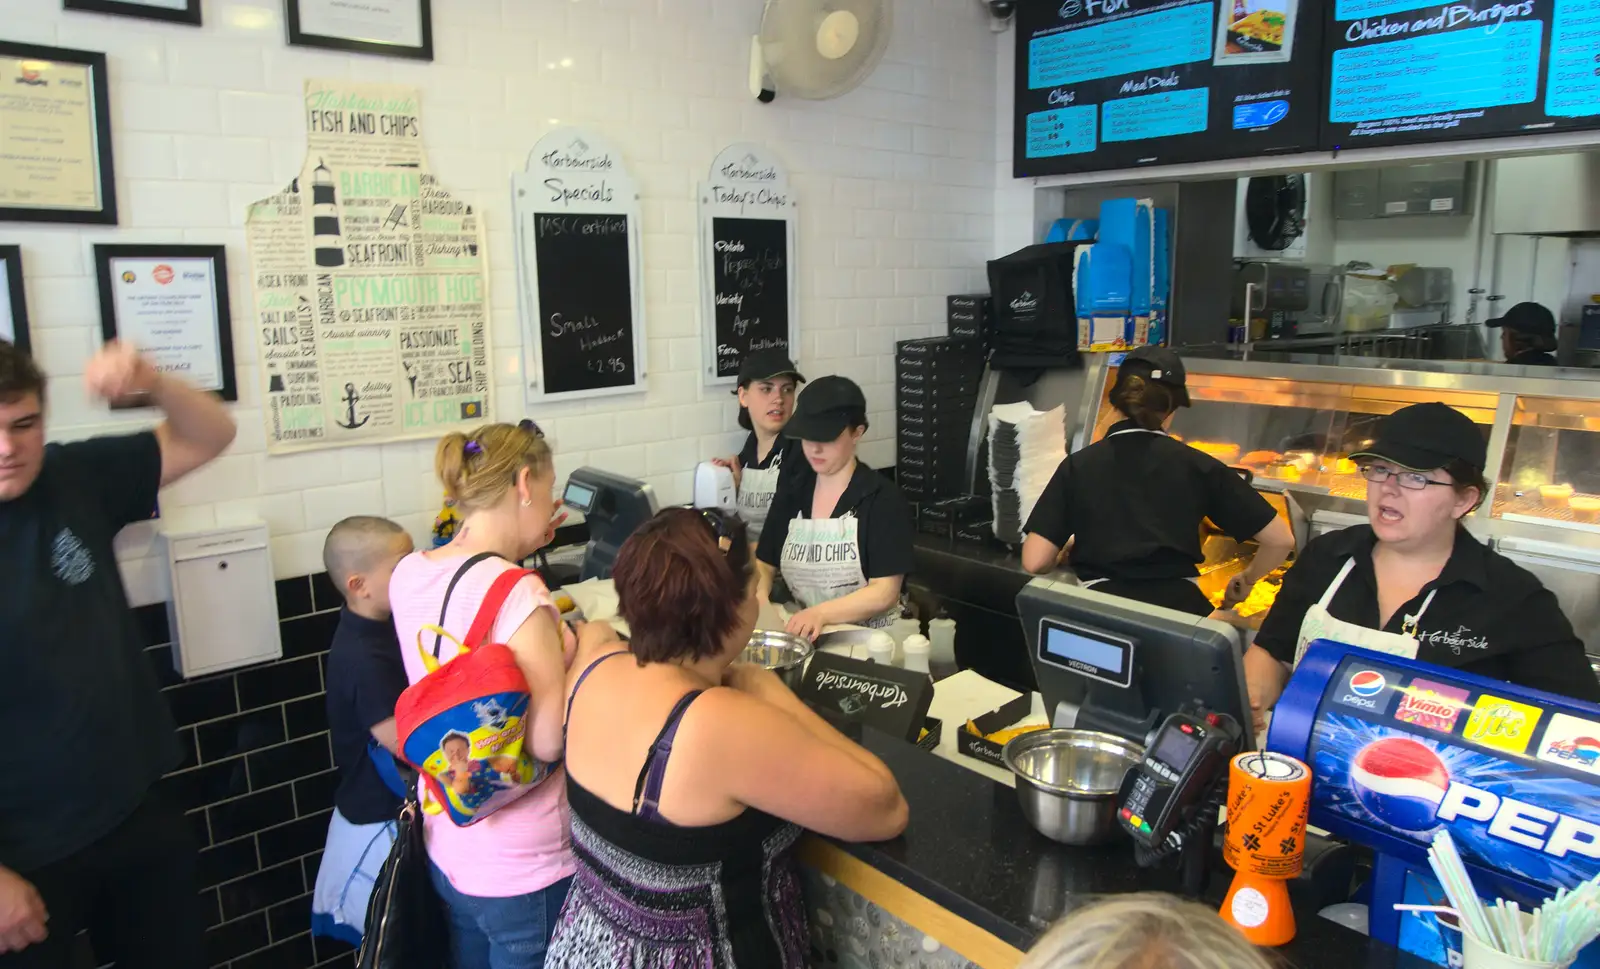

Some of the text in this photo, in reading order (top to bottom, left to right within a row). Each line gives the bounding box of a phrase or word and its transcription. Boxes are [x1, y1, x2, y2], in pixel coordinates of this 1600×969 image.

[1345, 19, 1409, 42] Chicken
[1410, 6, 1448, 32] and
[1446, 0, 1535, 35] Burgers
[1119, 71, 1180, 94] Meal Deals
[1047, 88, 1076, 106] Chips
[311, 109, 418, 137] FISH AND CHIPS
[541, 149, 613, 169] Harbourside
[721, 162, 777, 181] Harbourside
[340, 171, 420, 198] BARBICAN
[544, 177, 614, 207] Specials
[421, 200, 464, 215] HARBOUR
[712, 185, 787, 215] Today's Chips
[347, 243, 408, 263] SEAFRONT
[425, 242, 461, 258] Fishing
[714, 240, 746, 253] Potato
[283, 273, 308, 287] FRONT
[316, 273, 336, 325] BARBICAN
[335, 275, 484, 308] PLYMOUTH HOE
[715, 292, 744, 313] Variety
[261, 310, 297, 325] SALT AIR
[352, 306, 399, 323] SEAFRONT
[297, 304, 317, 357] SEAGULLS
[322, 328, 391, 340] Award winning
[550, 312, 600, 338] Small
[262, 326, 299, 346] SAILS
[399, 329, 460, 350] PASSIONATE
[472, 321, 486, 366] BUILDING
[264, 348, 300, 360] Seaside
[717, 344, 740, 356] Farm
[447, 360, 472, 384] SEA
[587, 357, 626, 374] £2.95
[286, 371, 319, 384] SURFING
[361, 381, 393, 393] Sailing
[475, 370, 488, 393] SHIP
[280, 392, 322, 408] PADDLING
[429, 386, 454, 397] FRANCIS
[455, 384, 473, 395] DRAKE
[404, 401, 430, 428] ICE
[825, 542, 857, 562] CHIPS
[1418, 630, 1488, 650] Harbourside
[1068, 660, 1098, 674] VECTRON
[815, 671, 908, 709] Harbourside
[1343, 694, 1376, 709] pepsi
[1407, 695, 1453, 718] Vimto
[968, 741, 1006, 762] Harbours
[1546, 747, 1597, 767] PEPSI
[1231, 784, 1252, 810] Luke's
[1253, 791, 1290, 833] St Luke's
[1290, 822, 1301, 834] St
